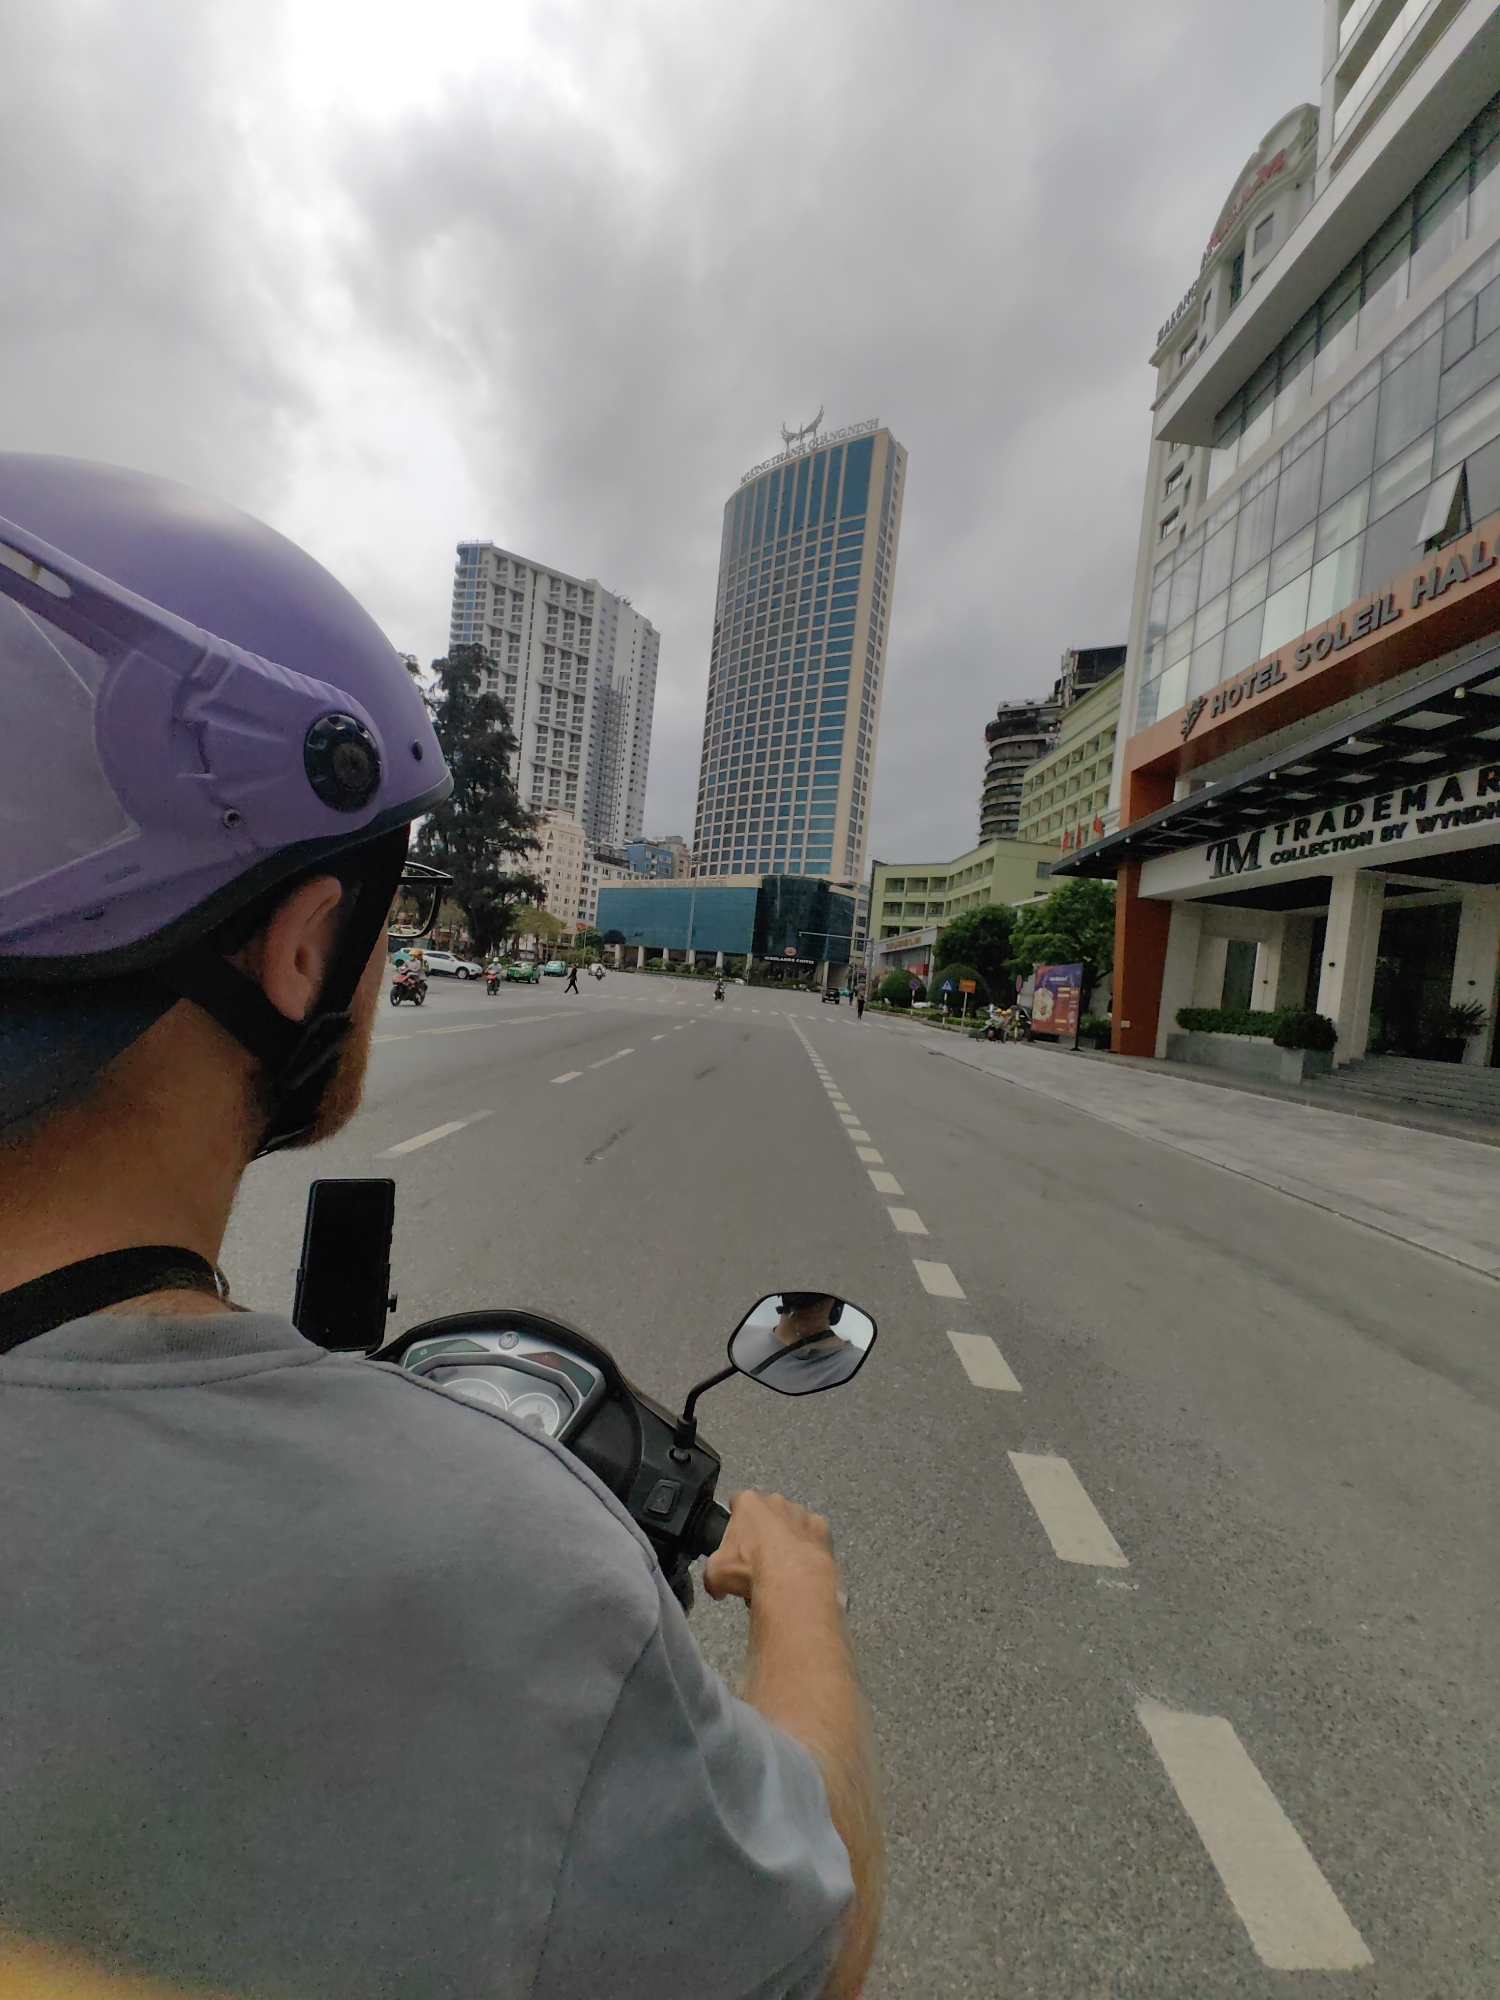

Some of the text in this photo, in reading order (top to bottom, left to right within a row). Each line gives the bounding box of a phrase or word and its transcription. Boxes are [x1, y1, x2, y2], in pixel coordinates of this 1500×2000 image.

[847, 418, 879, 437] NINH
[1209, 534, 1500, 718] HOTEL SOLEIL HAL
[1269, 830, 1374, 866] COLLECTION
[1380, 822, 1408, 843] BY
